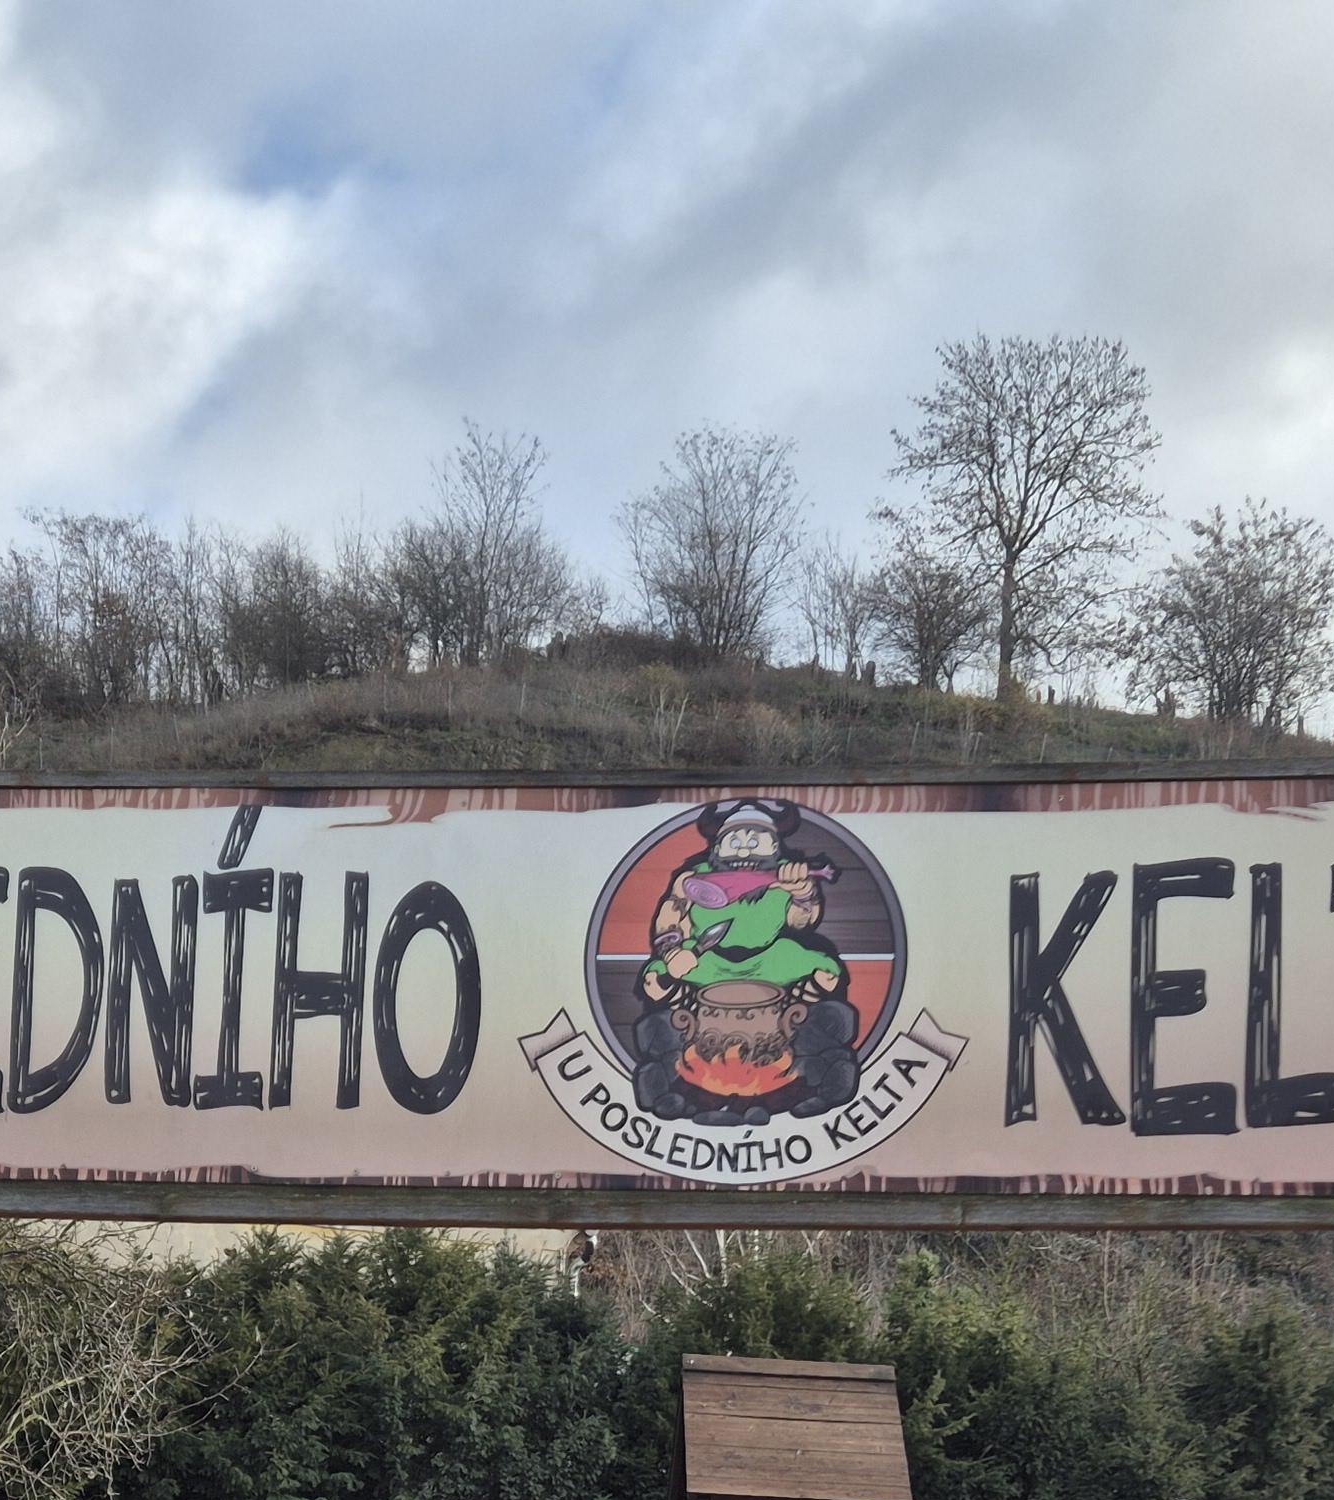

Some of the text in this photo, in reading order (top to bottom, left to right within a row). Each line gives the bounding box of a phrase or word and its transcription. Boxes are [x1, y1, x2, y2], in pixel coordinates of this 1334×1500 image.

[557, 1049, 929, 1174] U POSLEDNÍHO KELTA
